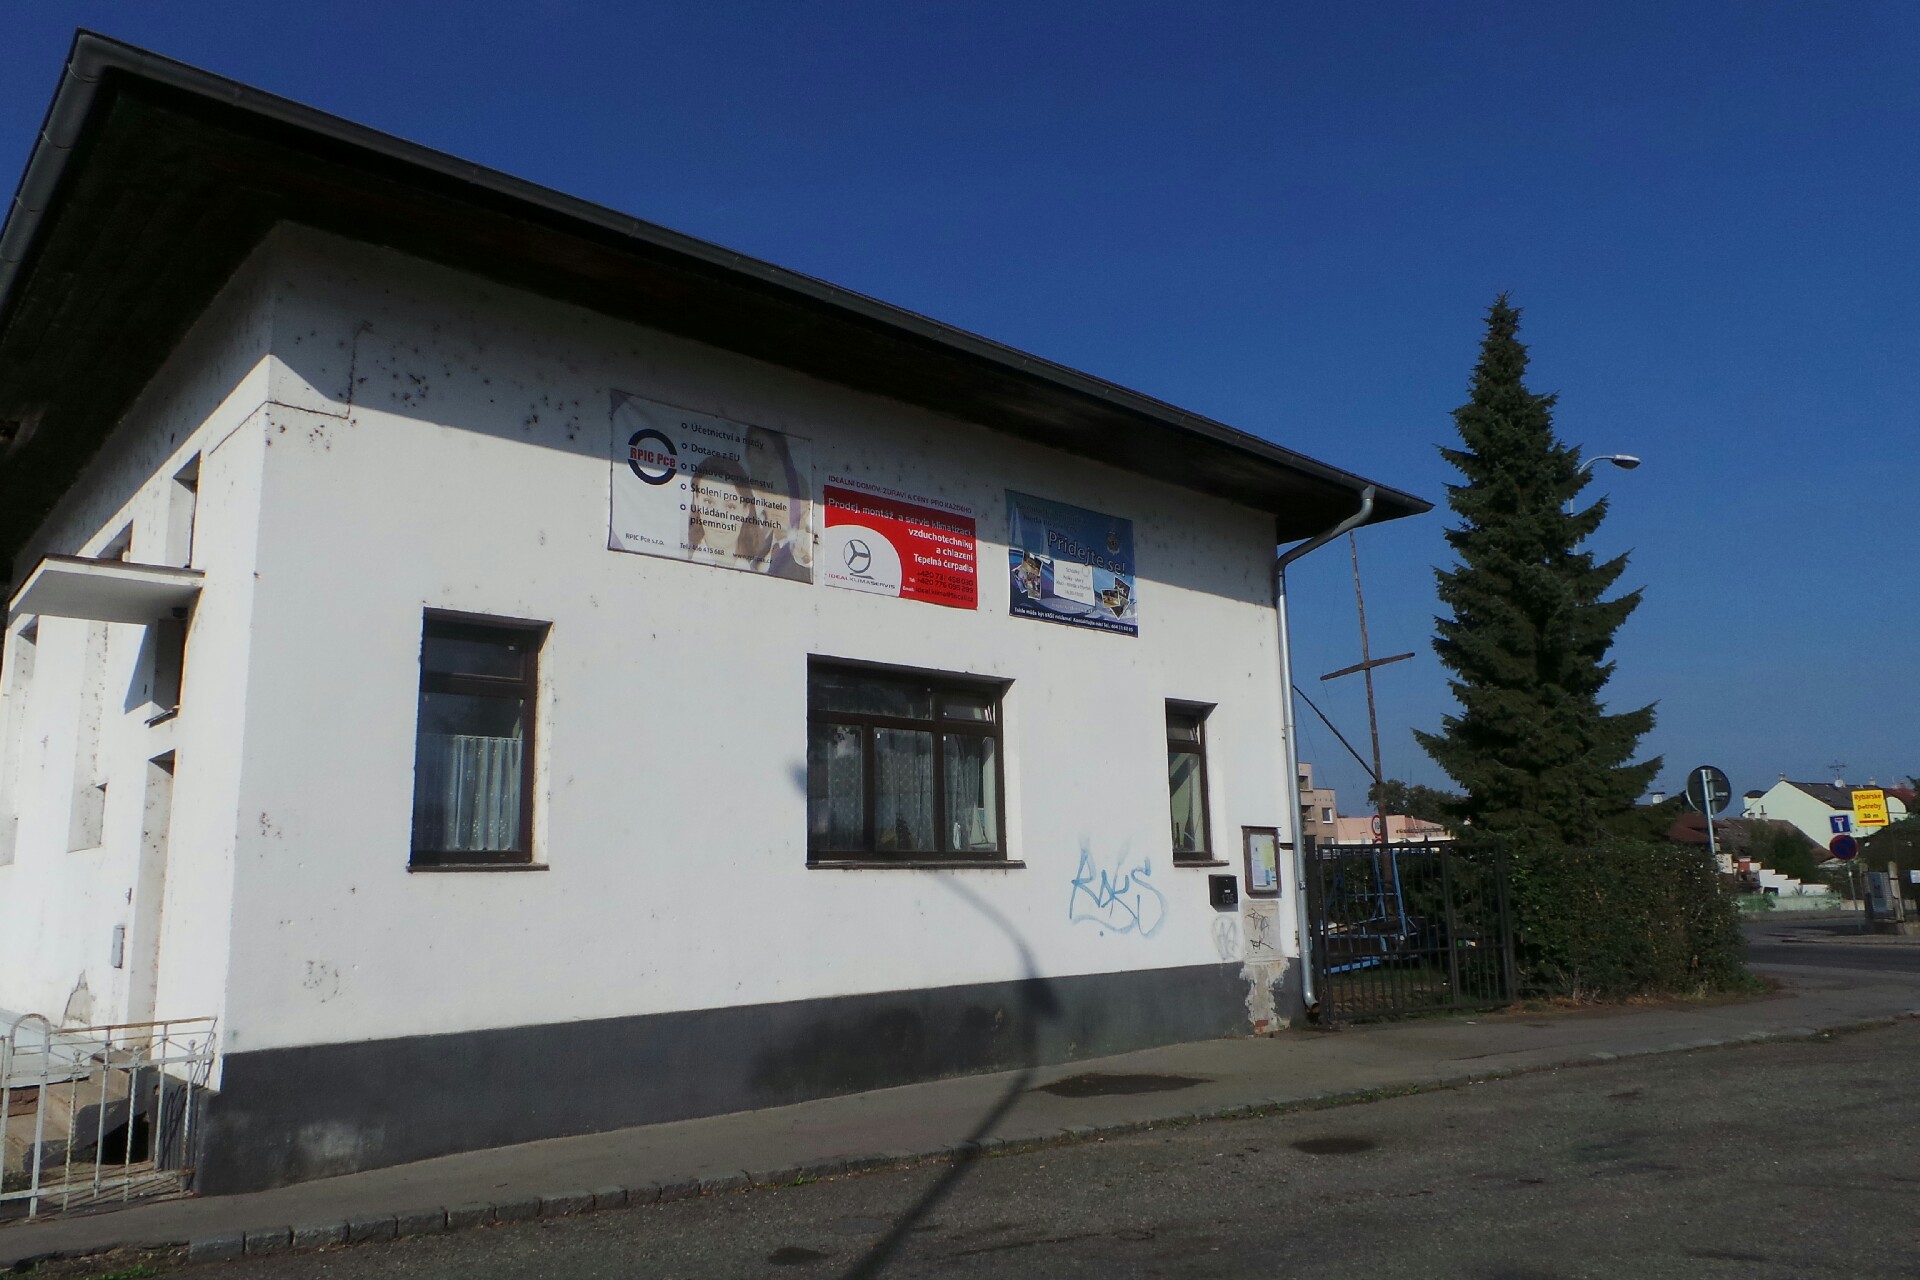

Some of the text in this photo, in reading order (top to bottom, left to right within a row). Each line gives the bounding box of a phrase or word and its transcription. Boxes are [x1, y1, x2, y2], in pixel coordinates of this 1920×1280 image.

[630, 446, 676, 468] RPIC Pce
[691, 443, 720, 458] Dotace
[728, 453, 740, 462] EU
[723, 492, 738, 501] pro
[740, 494, 787, 512] podnikatele
[690, 504, 782, 530] Ukládání nearchivních
[828, 497, 861, 514] Prodej,
[905, 516, 930, 528] servis
[908, 528, 973, 550] vzduchotechniky
[936, 546, 942, 554] a
[914, 553, 942, 568] Tepelná
[1107, 560, 1126, 577] se!
